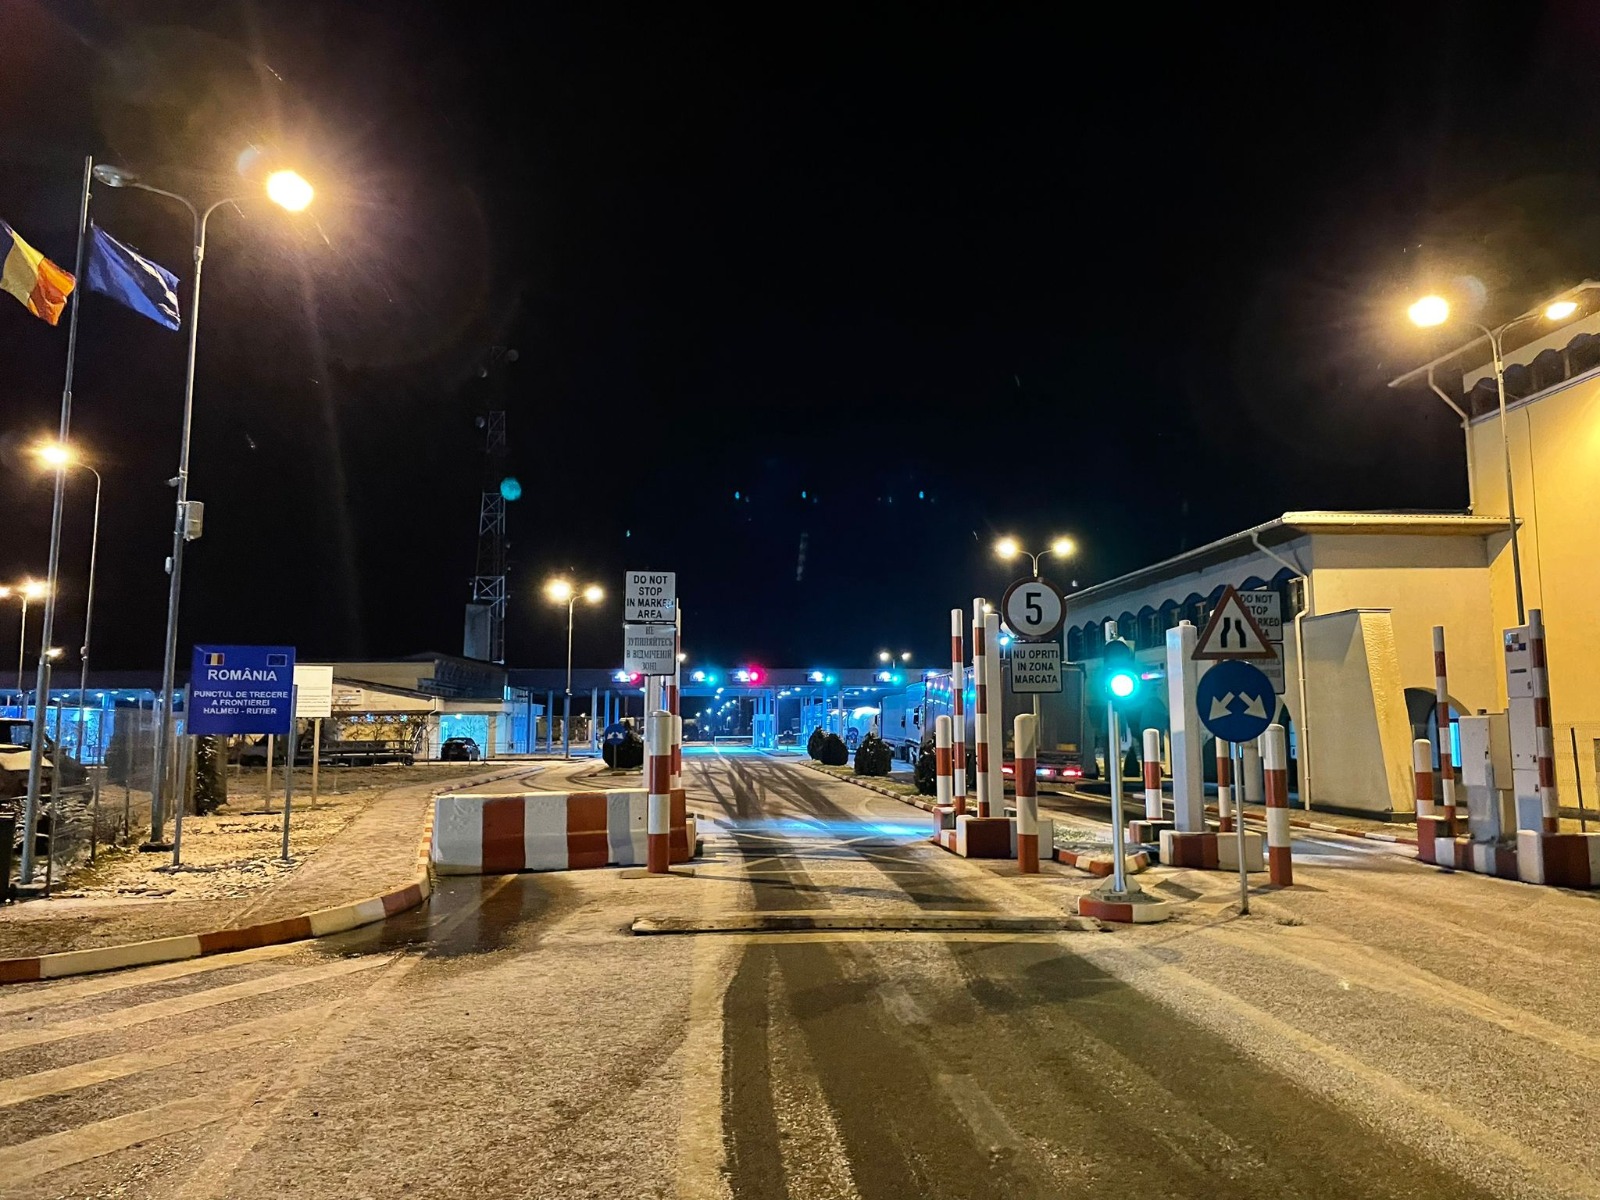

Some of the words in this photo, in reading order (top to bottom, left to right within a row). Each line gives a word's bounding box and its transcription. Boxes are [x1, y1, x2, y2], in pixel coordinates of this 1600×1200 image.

[634, 575, 646, 584] DO
[650, 576, 668, 584] NOT
[638, 586, 662, 596] STOP
[626, 598, 635, 606] IN
[1254, 594, 1272, 604] NOT
[1026, 592, 1042, 626] 5
[1250, 606, 1268, 614] TOP
[637, 610, 662, 618] AREA
[646, 626, 654, 634] НЕ
[1014, 650, 1026, 658] NU
[1028, 650, 1058, 658] OPRITI
[1018, 662, 1026, 671] IN
[1029, 662, 1054, 671] ZONA
[208, 668, 278, 682] ROMÂNIA
[1014, 674, 1058, 684] MARCATA
